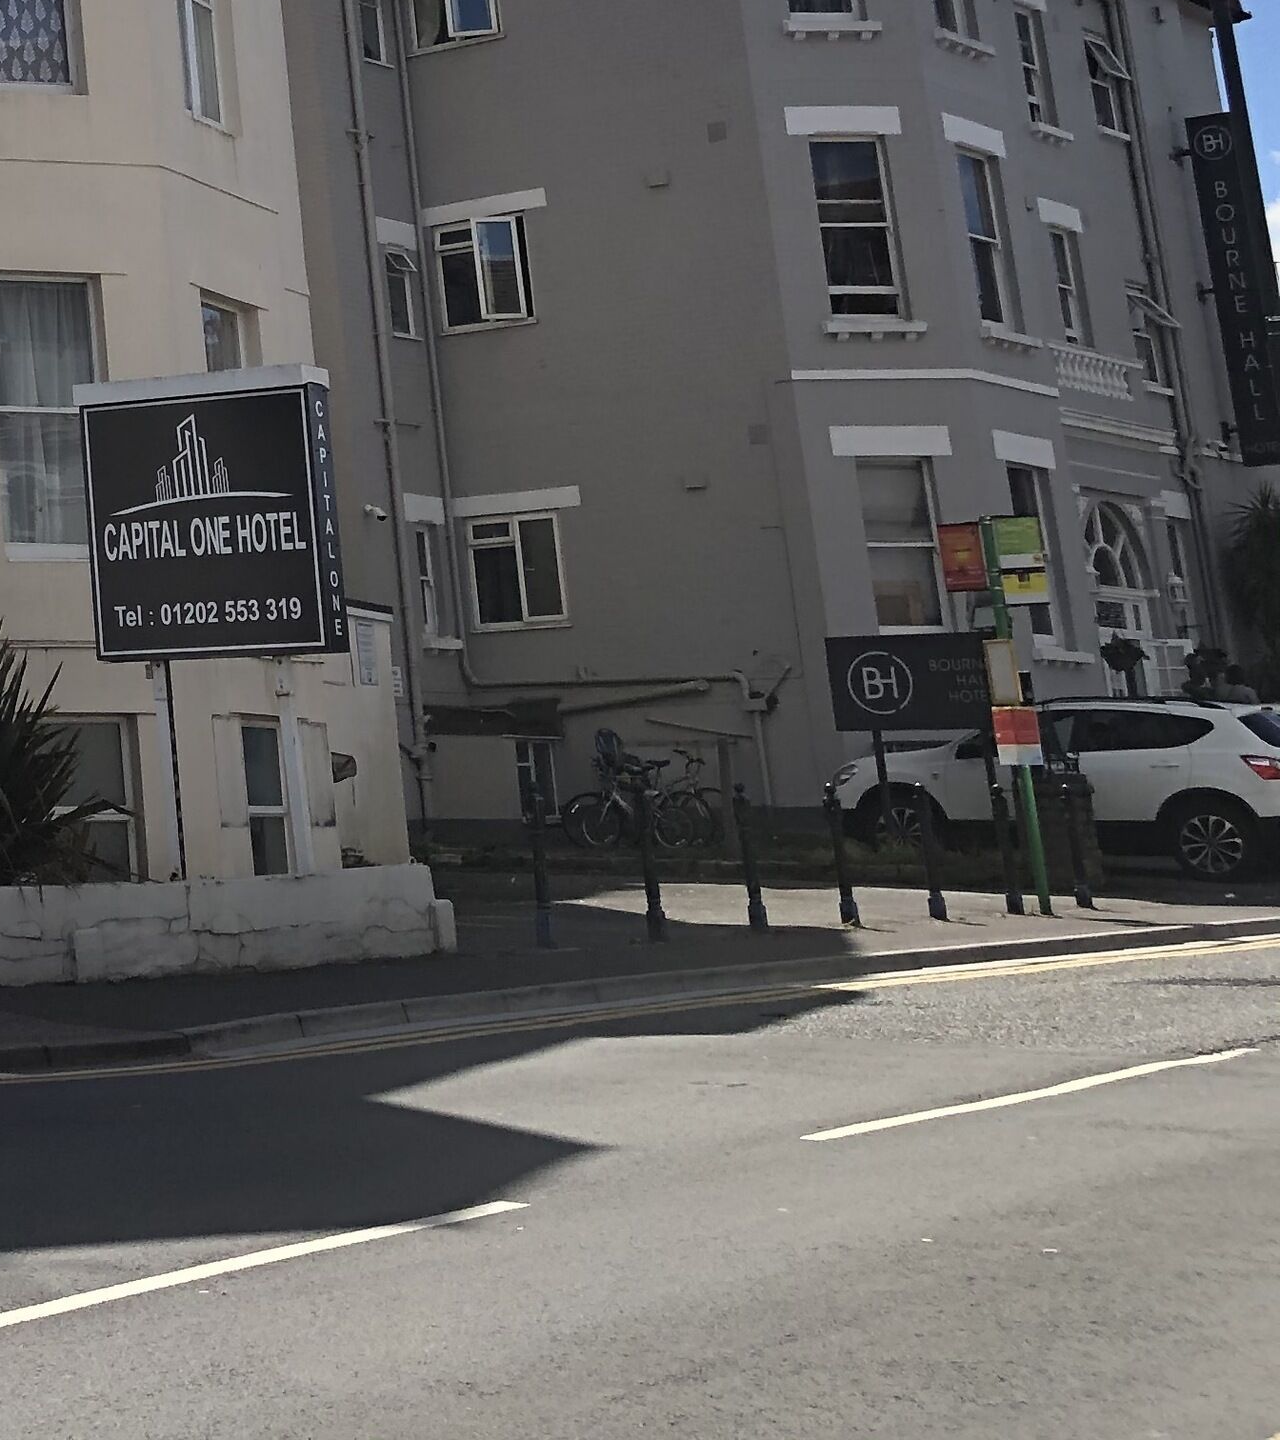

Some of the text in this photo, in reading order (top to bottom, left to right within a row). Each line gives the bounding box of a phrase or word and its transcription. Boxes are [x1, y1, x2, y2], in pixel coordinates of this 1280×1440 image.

[1214, 180, 1248, 313] BOURNE
[1240, 331, 1265, 421] HALL
[104, 511, 307, 562] CAPITAL ONE HOTEL
[315, 400, 343, 636] CAPITAL ONE
[160, 600, 219, 625] 01202
[225, 599, 260, 622] 553
[266, 596, 302, 620] 319
[928, 658, 984, 672] BOURN
[948, 690, 987, 703] HOTE
